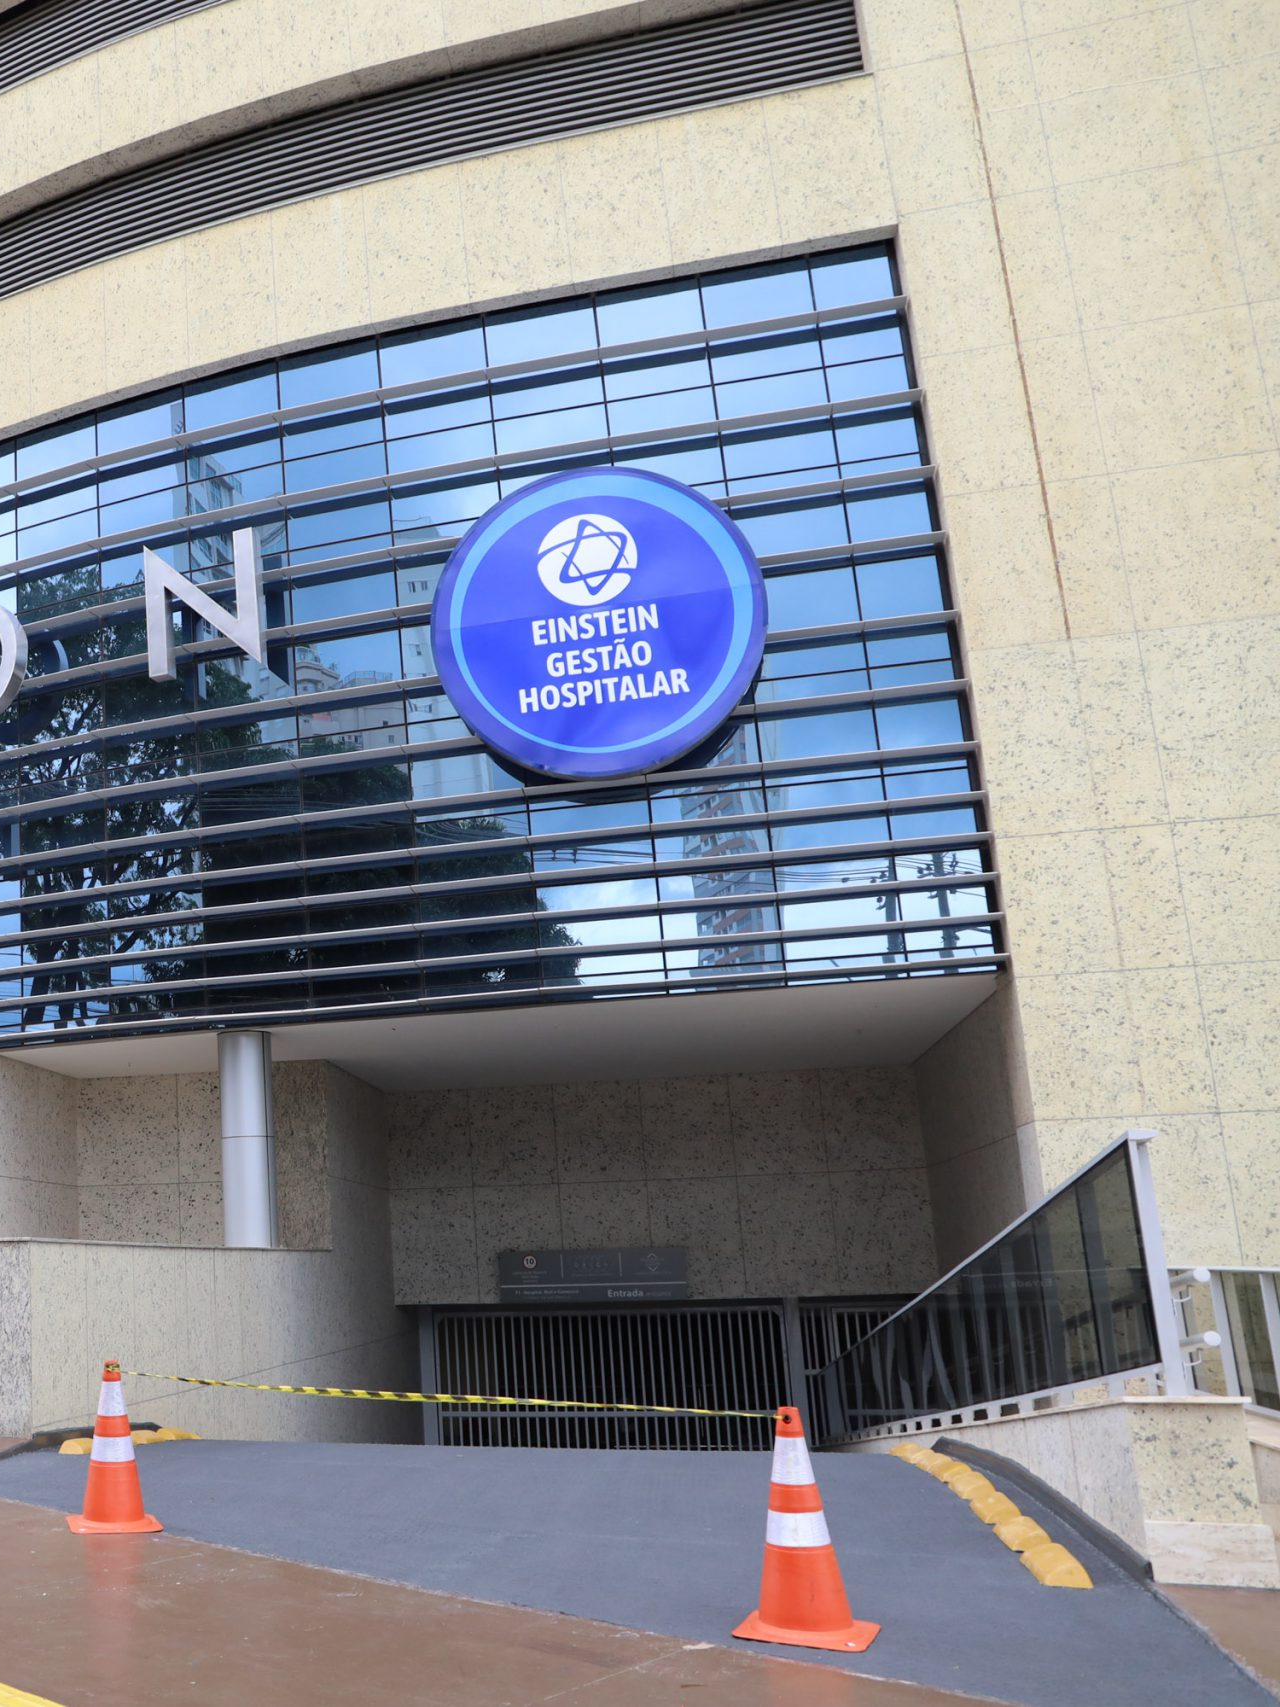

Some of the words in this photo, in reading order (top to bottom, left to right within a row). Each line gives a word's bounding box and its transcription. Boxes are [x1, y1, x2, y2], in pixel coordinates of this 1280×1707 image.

[531, 603, 660, 646] EINSTEIN
[546, 638, 652, 678] GESTÃO
[519, 668, 690, 714] HOSPITALAR
[607, 1289, 644, 1298] Entrada
